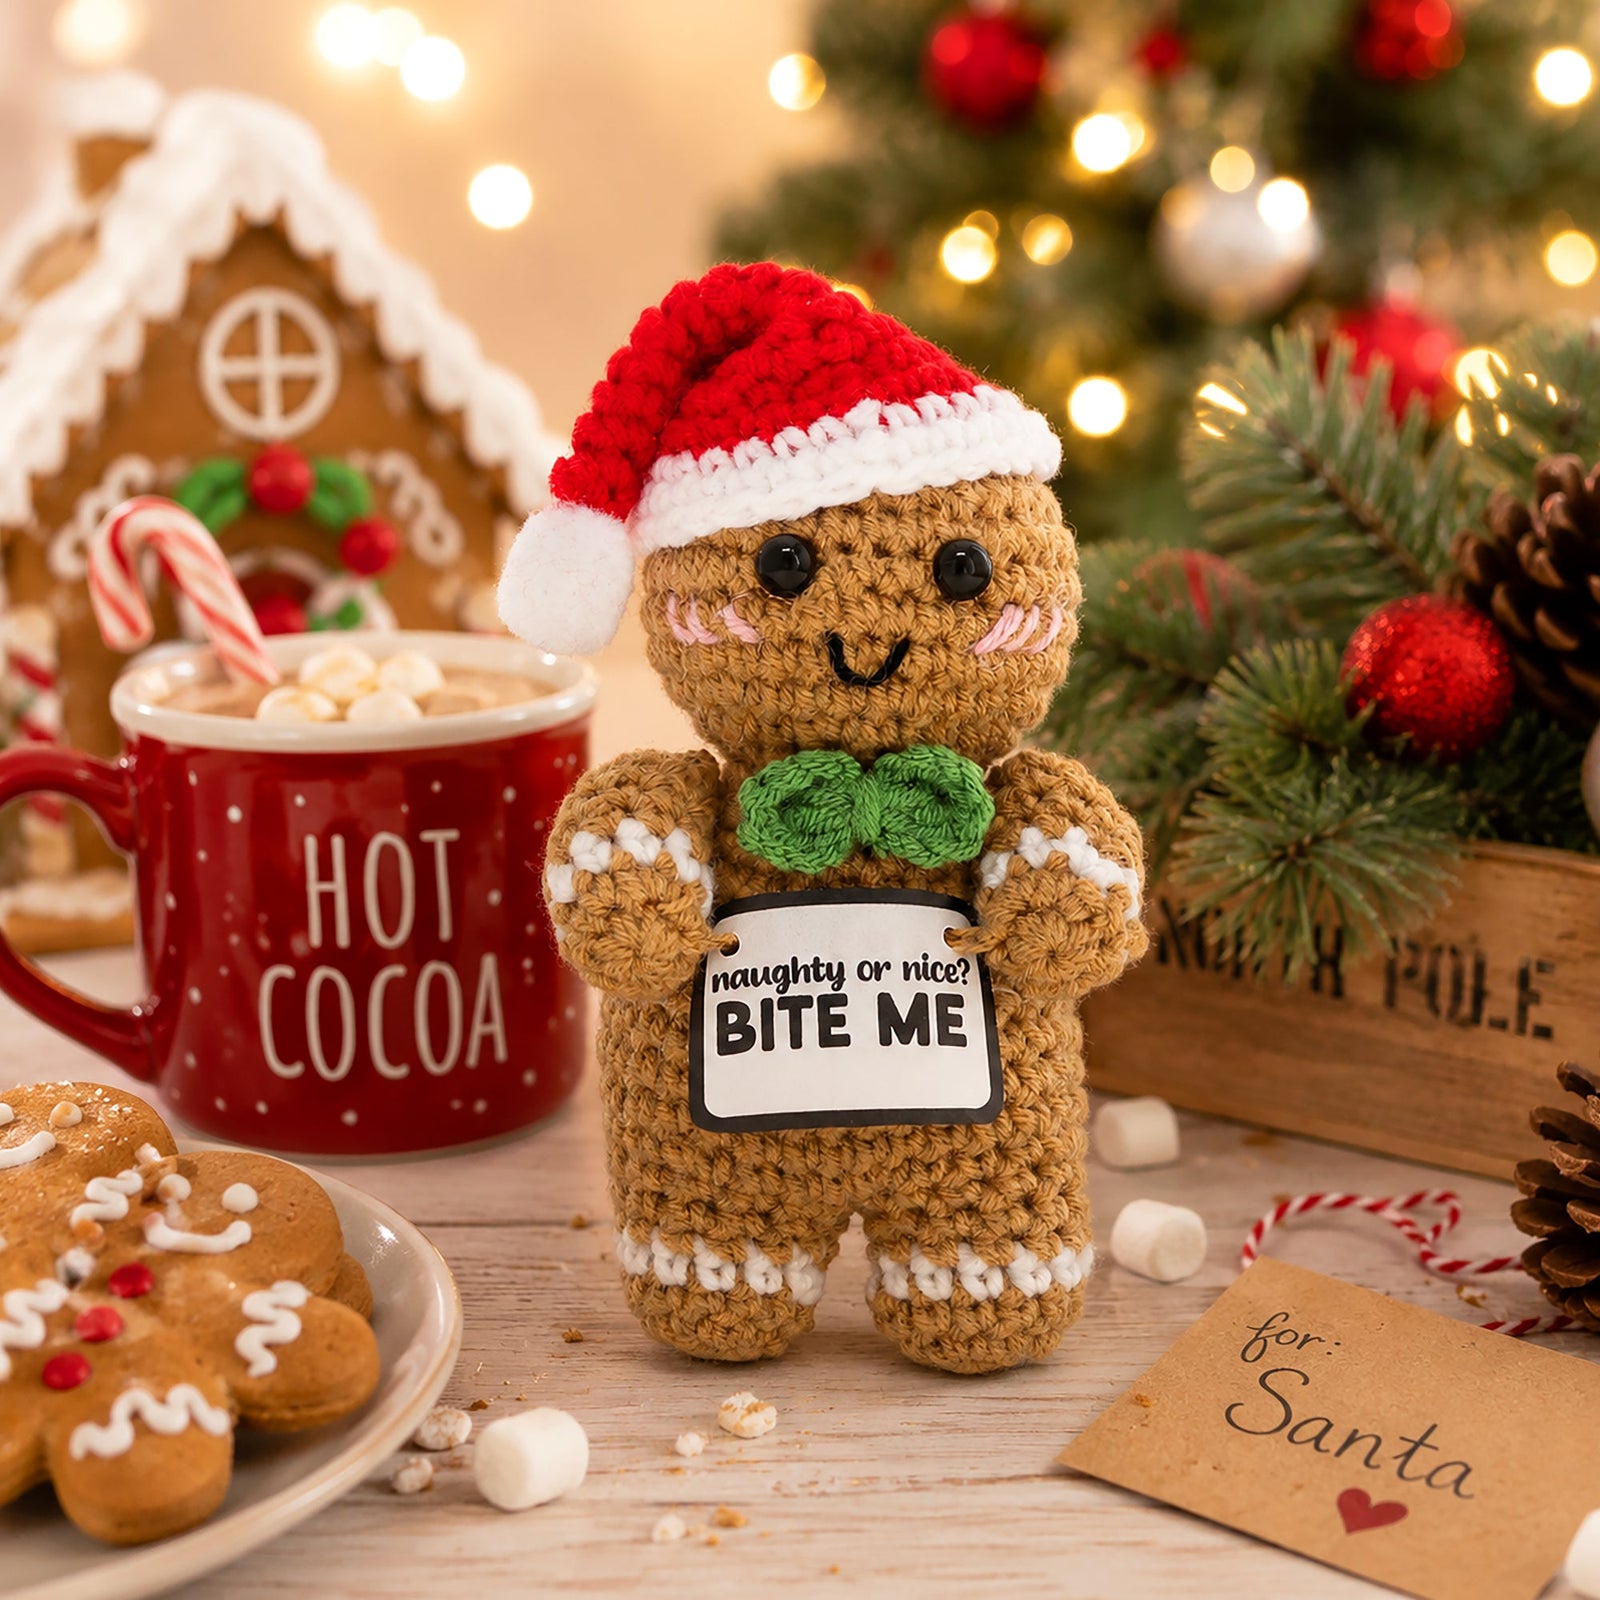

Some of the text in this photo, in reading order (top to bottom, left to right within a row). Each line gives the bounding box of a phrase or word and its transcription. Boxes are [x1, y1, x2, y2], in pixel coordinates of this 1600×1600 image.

[304, 829, 460, 949] HOT
[258, 953, 508, 1082] COCOA
[712, 953, 970, 994] naughty or nice?
[717, 992, 967, 1056] BITE ME
[1384, 937, 1555, 1040] POLE
[1241, 1312, 1341, 1363] for:
[1225, 1368, 1474, 1499] Santa
